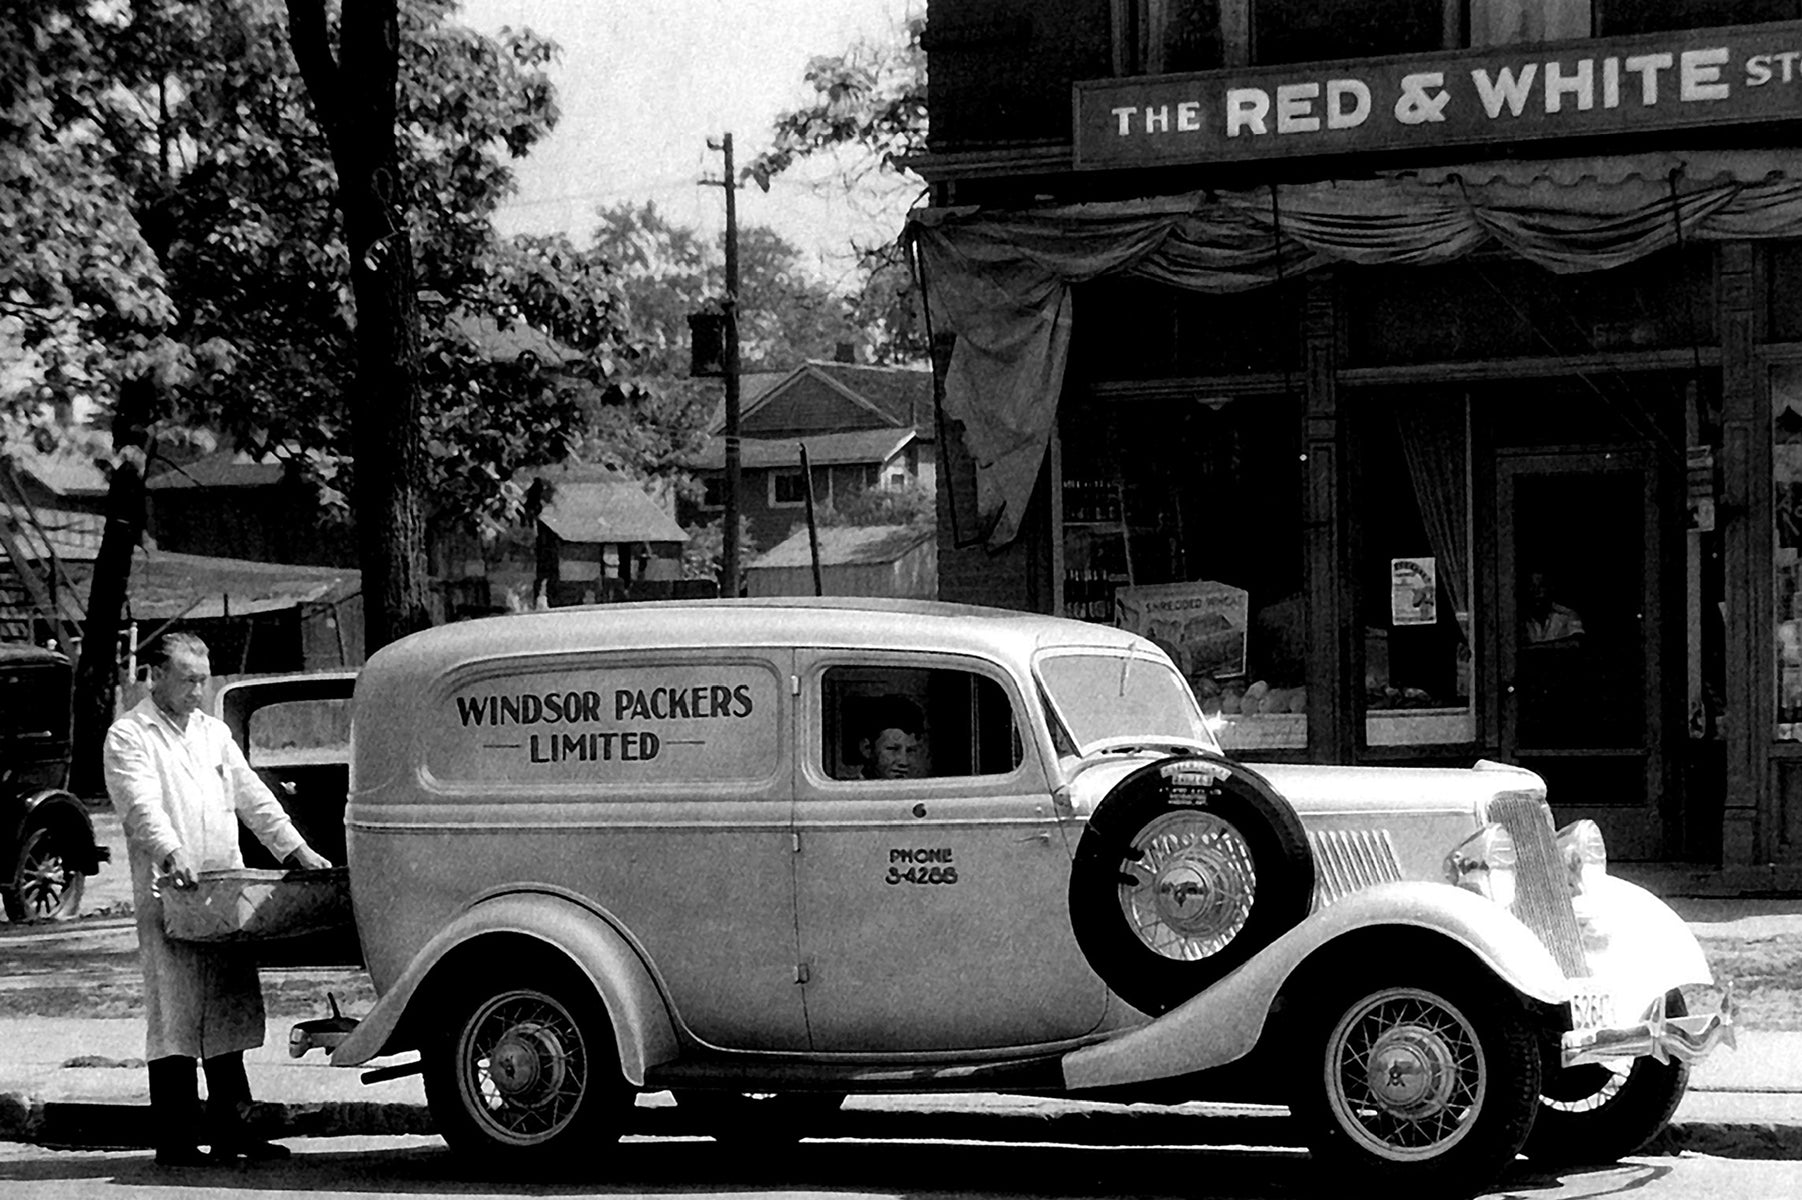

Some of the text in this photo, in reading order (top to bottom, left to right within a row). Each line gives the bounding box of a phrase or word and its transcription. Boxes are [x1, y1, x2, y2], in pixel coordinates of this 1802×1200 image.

[1111, 46, 1802, 137] THE RED & WHITE ST
[455, 684, 753, 728] WINDSOR PACKERS
[530, 731, 660, 764] LIMITED
[889, 847, 954, 864] PHONE
